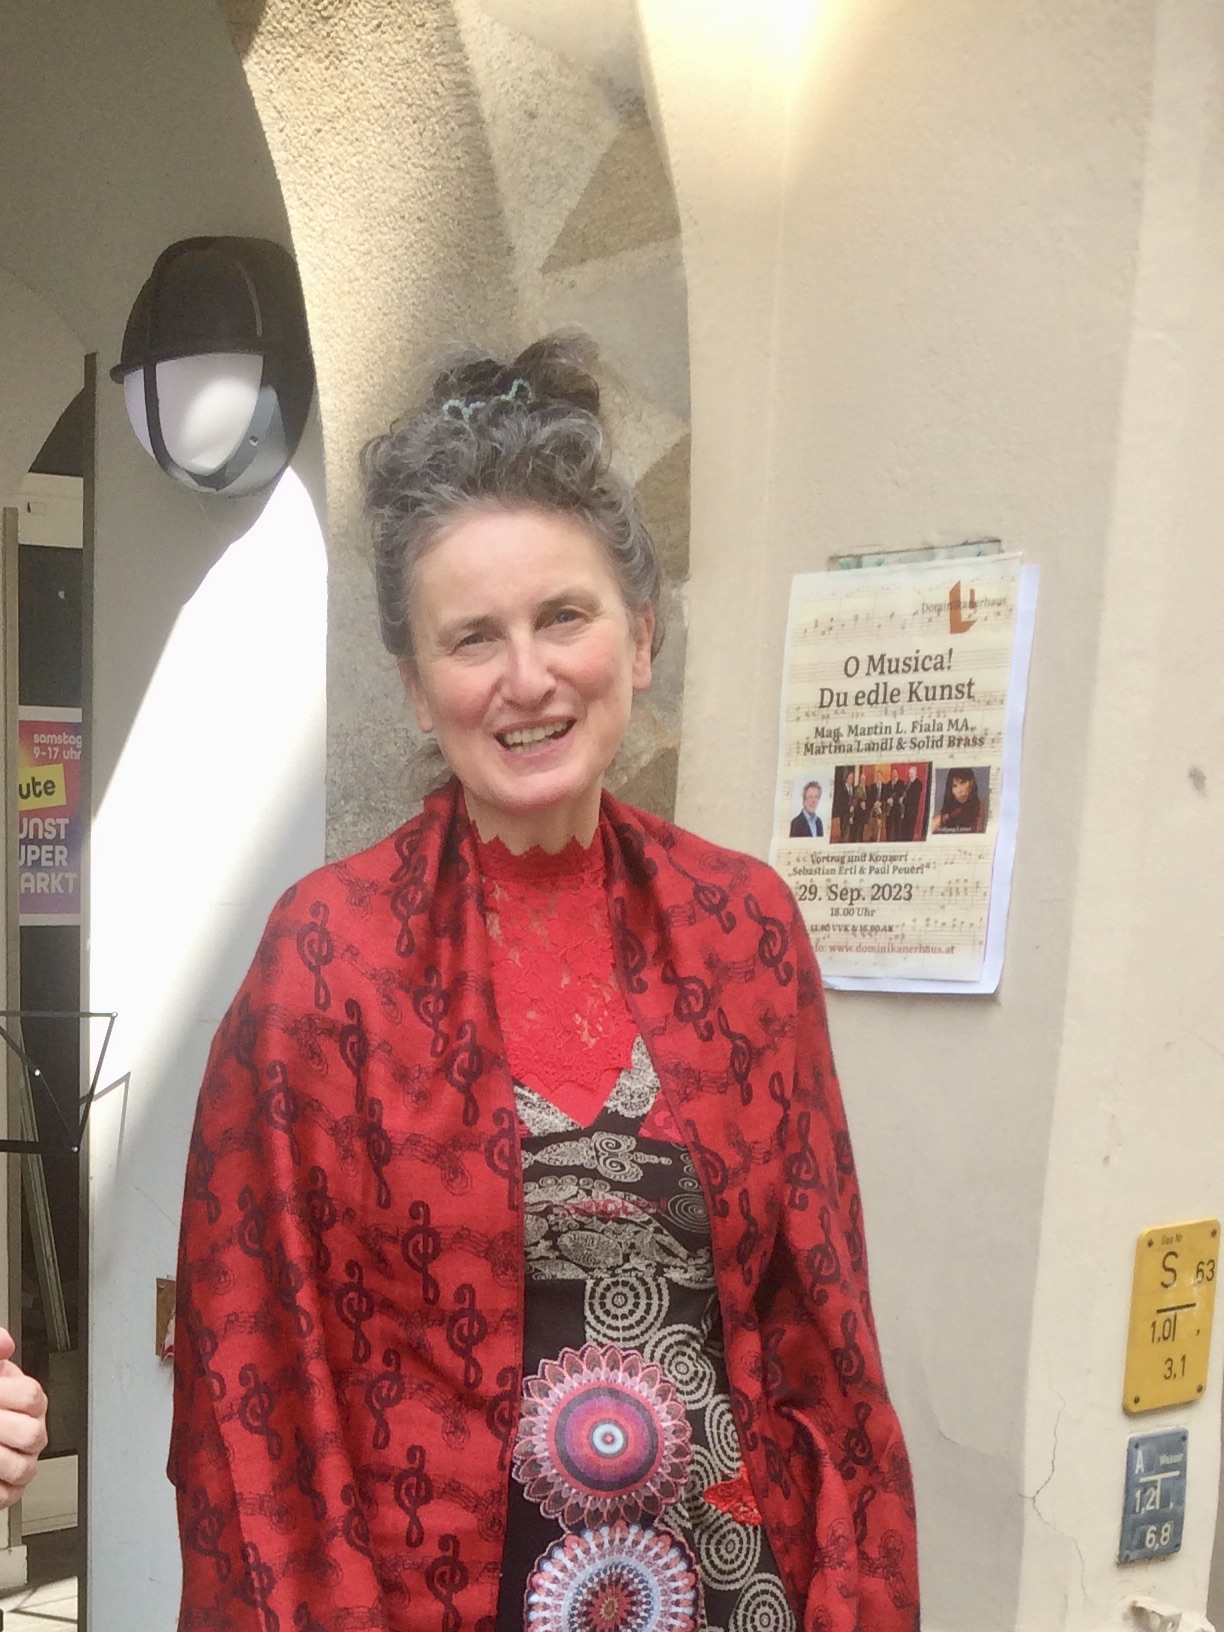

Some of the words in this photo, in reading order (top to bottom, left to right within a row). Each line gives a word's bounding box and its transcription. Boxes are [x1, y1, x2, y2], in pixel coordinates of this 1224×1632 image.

[843, 655, 861, 679] O
[864, 647, 954, 677] Musica!
[818, 686, 849, 709] Du
[854, 681, 902, 707] edle
[906, 676, 976, 703] Kunst
[33, 731, 82, 749] samstag
[814, 726, 844, 743] Mag.
[847, 722, 892, 738] Martin
[895, 721, 907, 735] L.
[910, 718, 944, 734] Fiala
[33, 746, 60, 760] 9-17
[62, 746, 82, 760] uhr
[803, 740, 853, 756] Martina
[855, 737, 894, 753] Landl
[895, 738, 906, 751] &
[908, 734, 944, 750] Solid
[947, 732, 985, 748] Brass
[18, 775, 56, 800] ute
[19, 817, 69, 840] UNST
[19, 845, 68, 867] UPER
[20, 872, 77, 894] ARKT
[798, 883, 822, 902] 29.
[827, 882, 866, 905] Sep.
[870, 882, 914, 902] 2023
[830, 907, 855, 917] 18.00
[857, 907, 876, 917] Uhr
[1160, 1251, 1178, 1289] S
[1196, 1258, 1216, 1285] 63
[1135, 1449, 1145, 1475] A
[1145, 1522, 1172, 1552] 6,8
